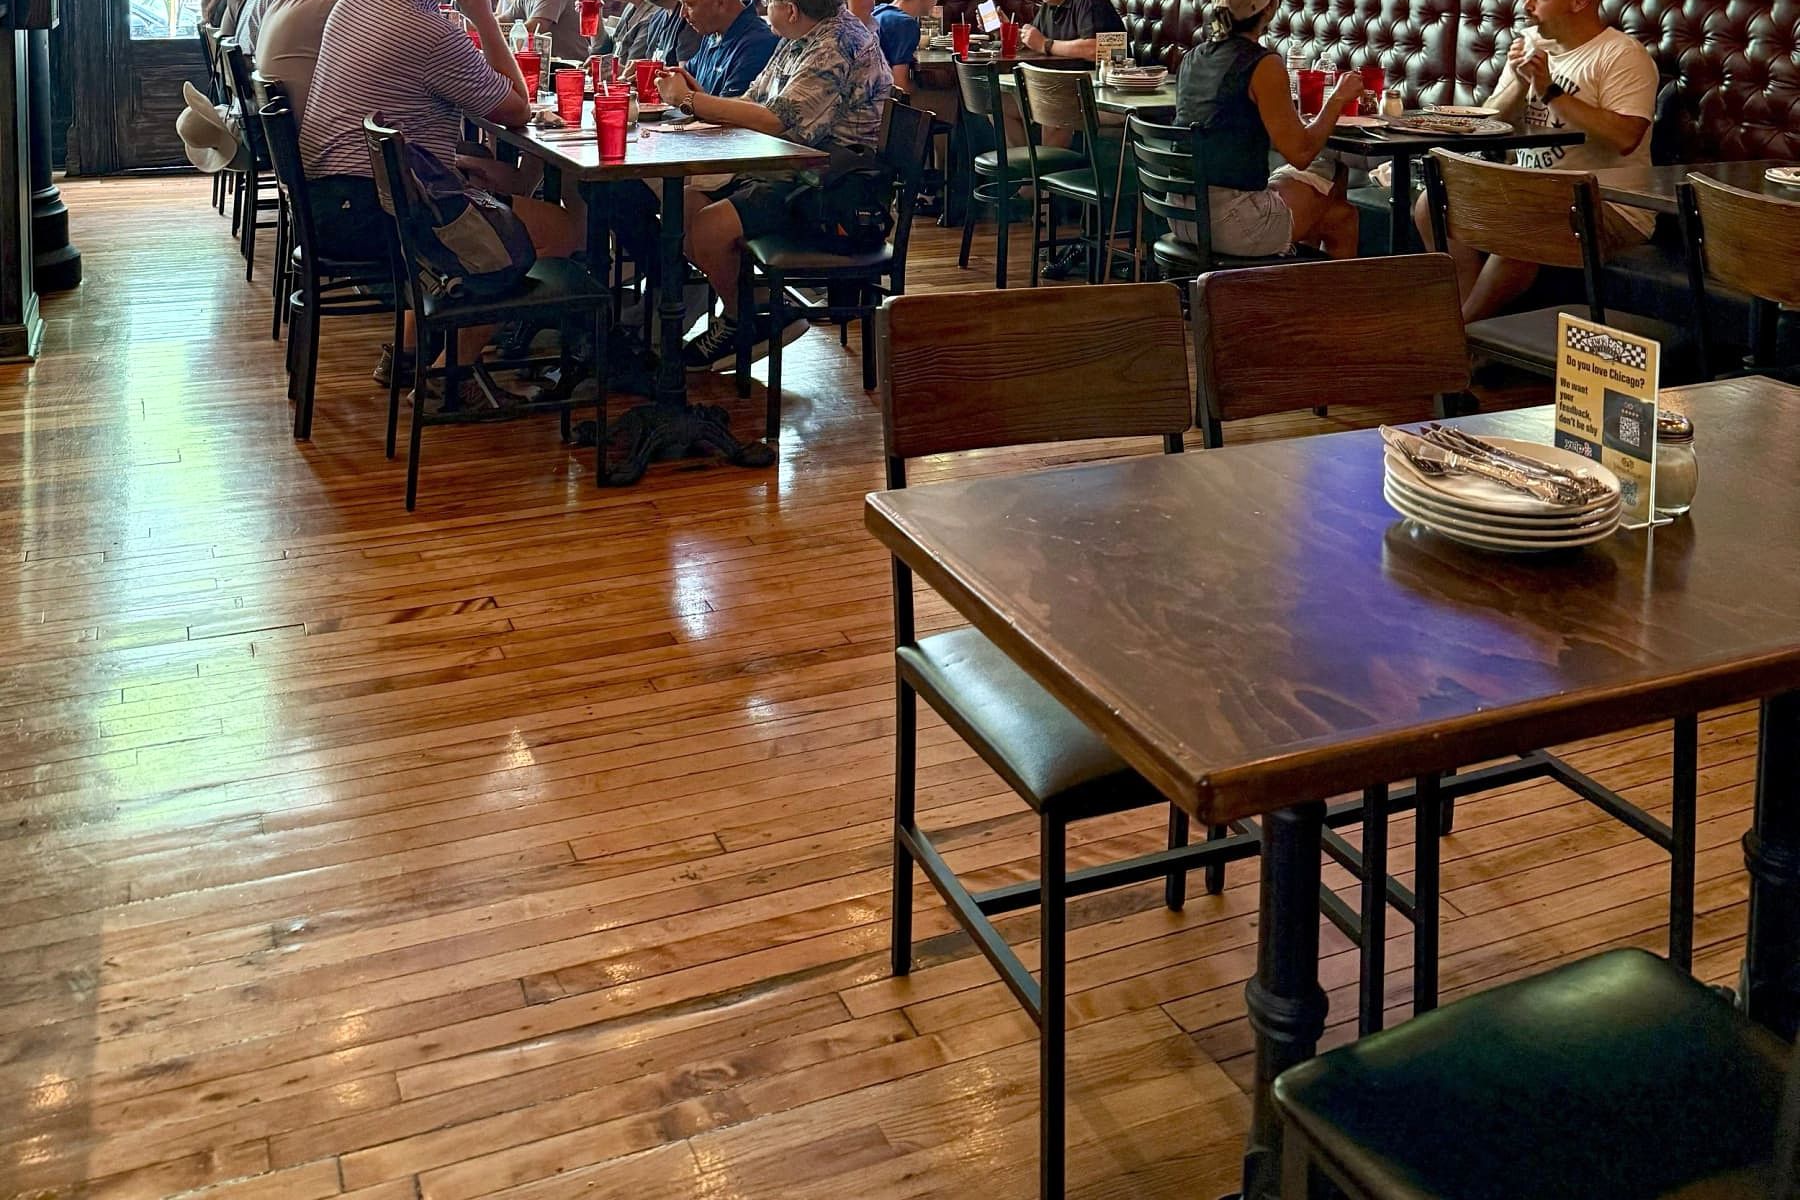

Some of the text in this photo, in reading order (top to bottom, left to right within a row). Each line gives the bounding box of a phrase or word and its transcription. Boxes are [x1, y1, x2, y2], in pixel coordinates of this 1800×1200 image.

[1566, 355, 1645, 389] Do you love Chicago?
[1560, 377, 1589, 394] We want
[1559, 391, 1574, 402] your
[1559, 401, 1592, 422] feedback,
[1558, 414, 1598, 437] don't be shy
